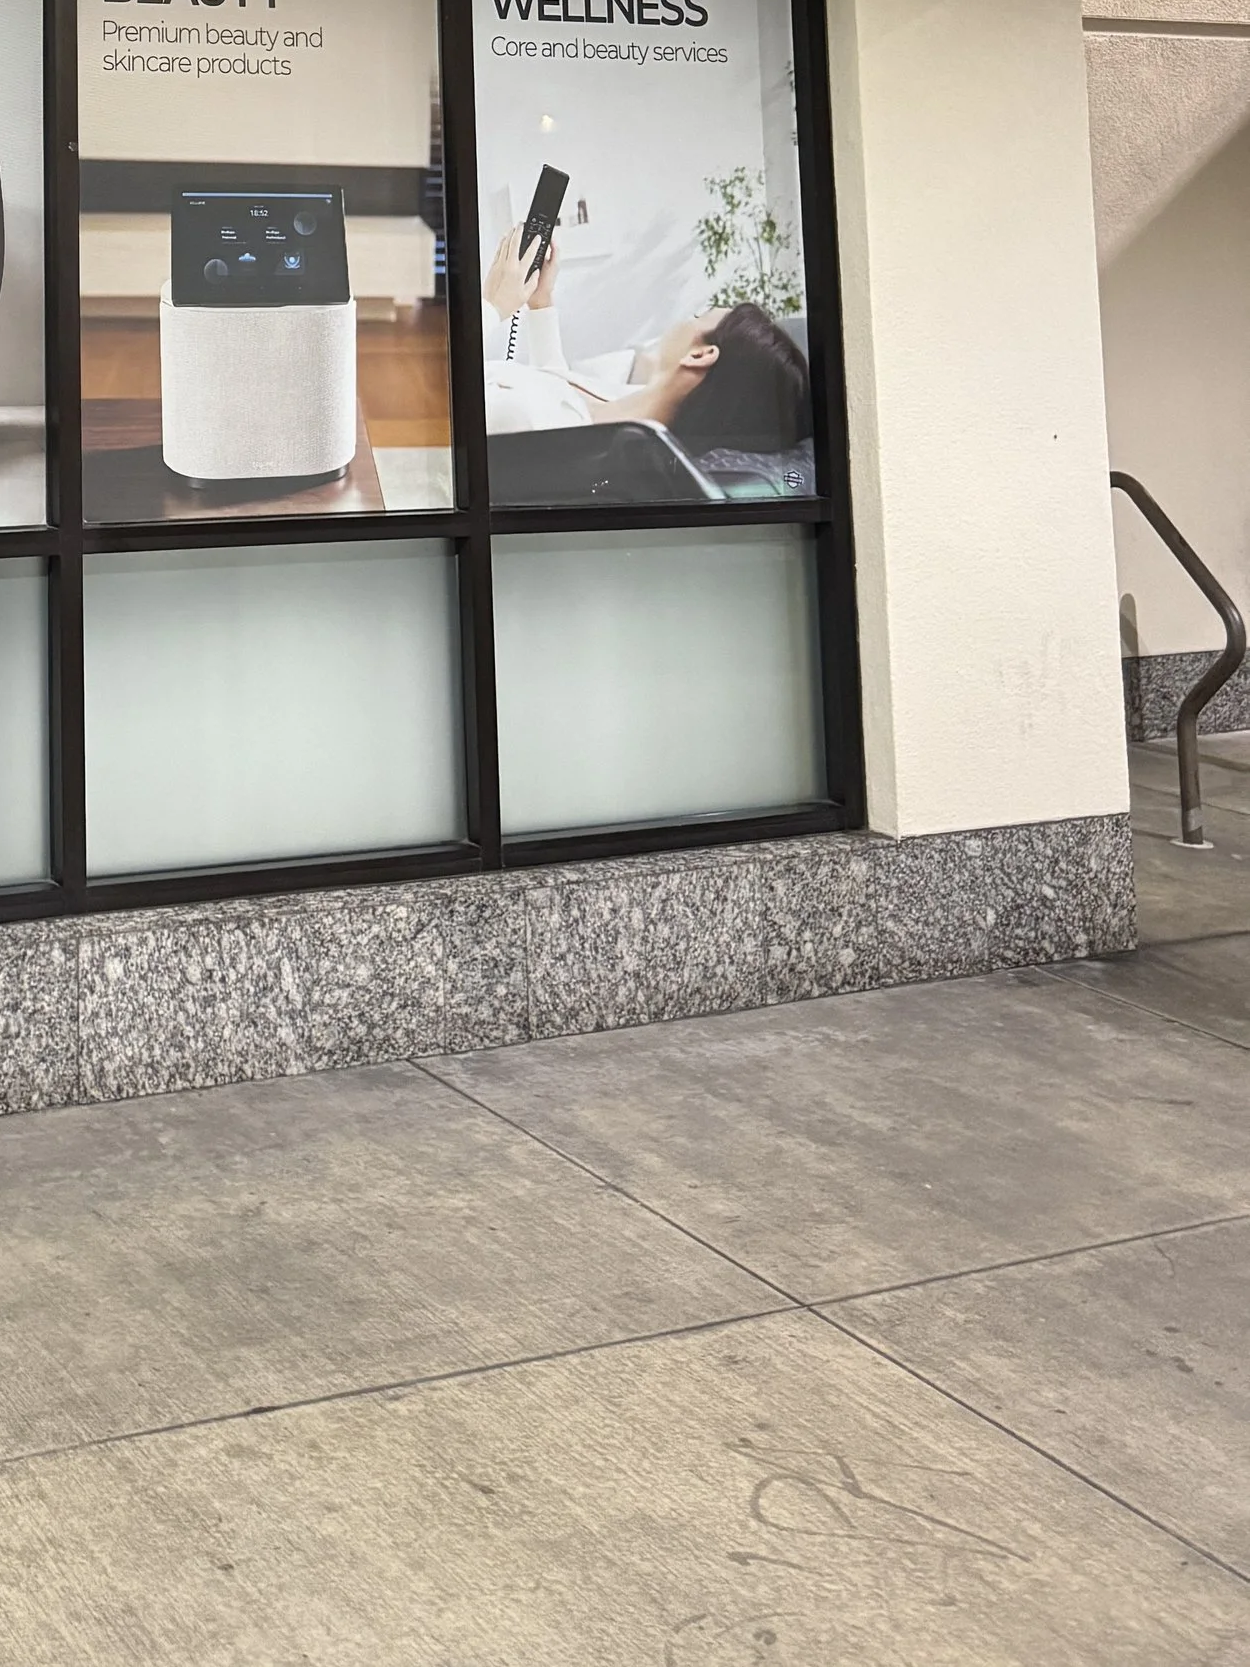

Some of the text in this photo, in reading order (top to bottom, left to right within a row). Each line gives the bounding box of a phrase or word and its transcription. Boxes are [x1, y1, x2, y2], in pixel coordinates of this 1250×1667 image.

[103, 20, 323, 52] Premium beauty and
[491, 36, 728, 66] Core and beauty services
[103, 49, 292, 78] skincare products
